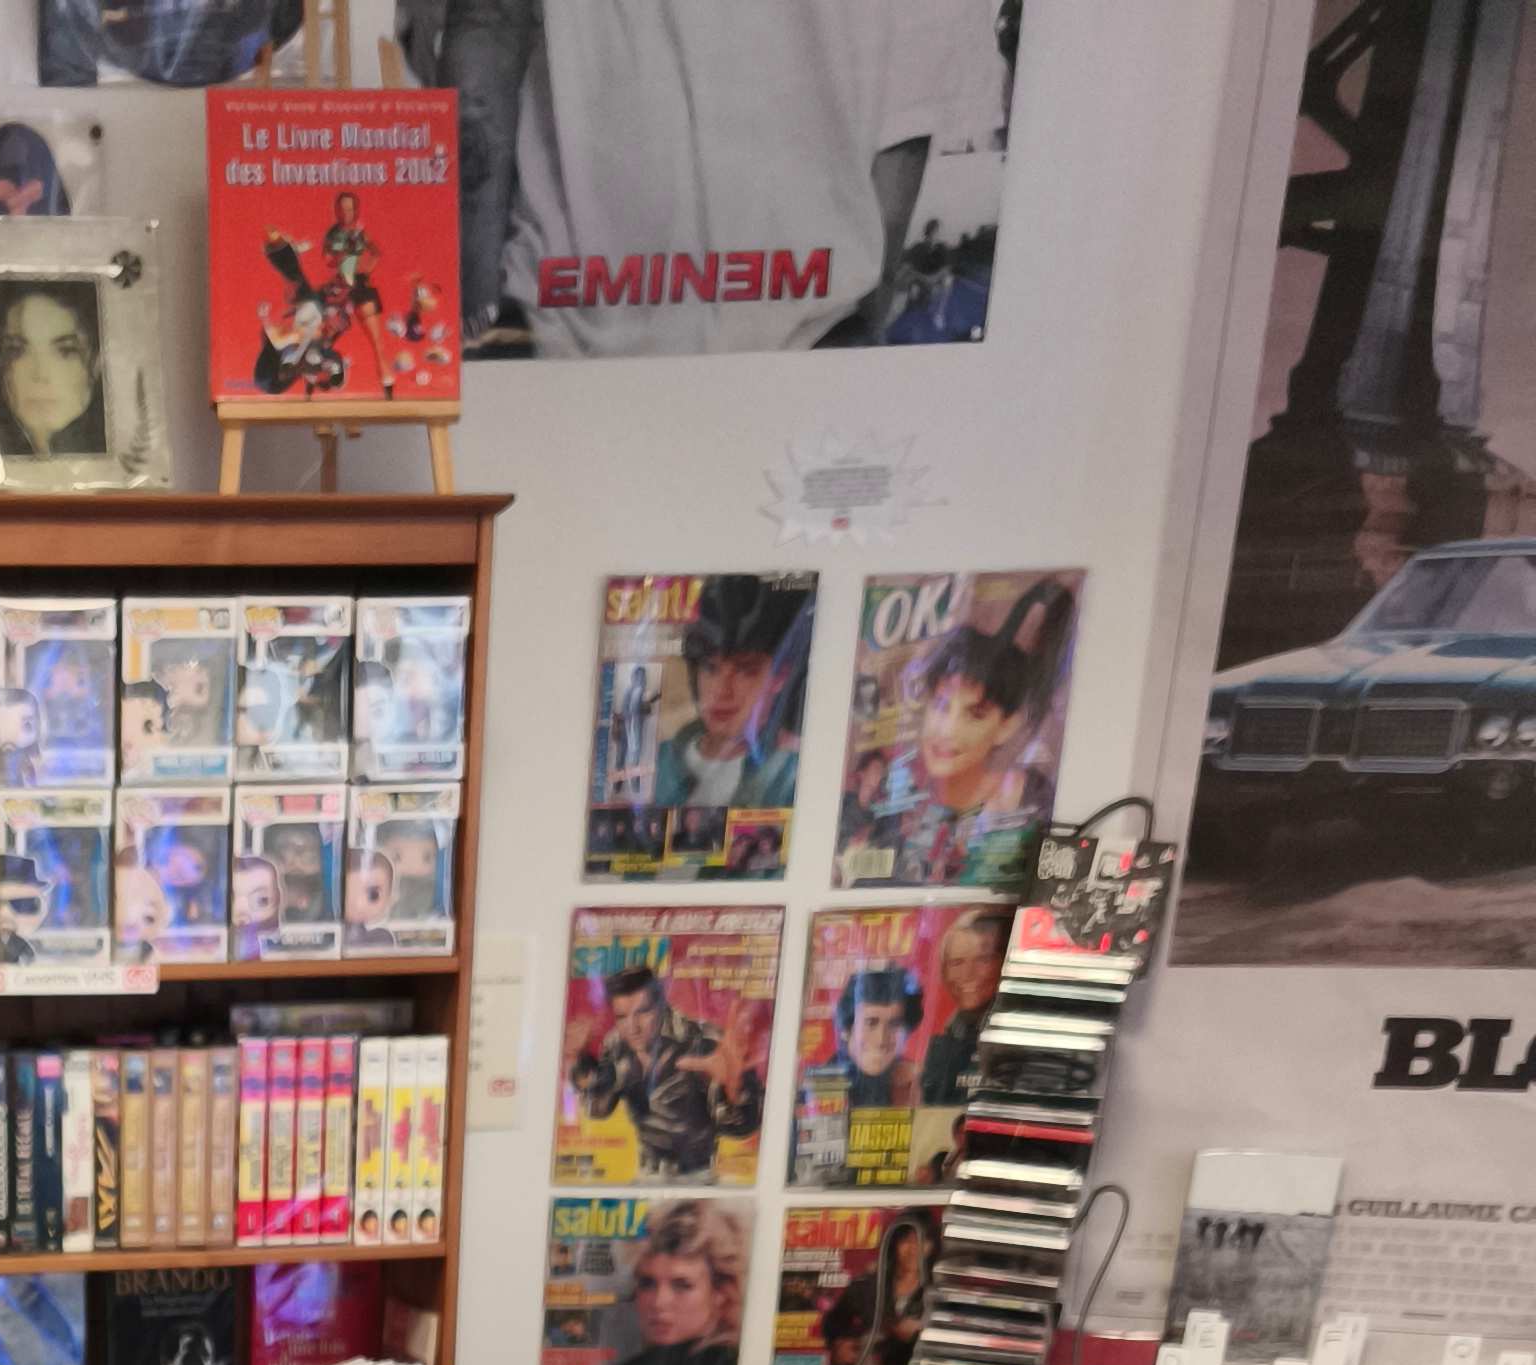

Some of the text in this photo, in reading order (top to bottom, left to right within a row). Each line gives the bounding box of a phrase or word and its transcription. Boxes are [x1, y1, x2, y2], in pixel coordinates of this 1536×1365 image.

[242, 122, 269, 150] Le
[277, 122, 333, 150] Livre
[225, 158, 265, 185] des
[272, 159, 388, 185] Inventions
[538, 249, 831, 309] EMINEM
[555, 1198, 647, 1237] salut!
[1348, 1200, 1503, 1223] GUILLAUME
